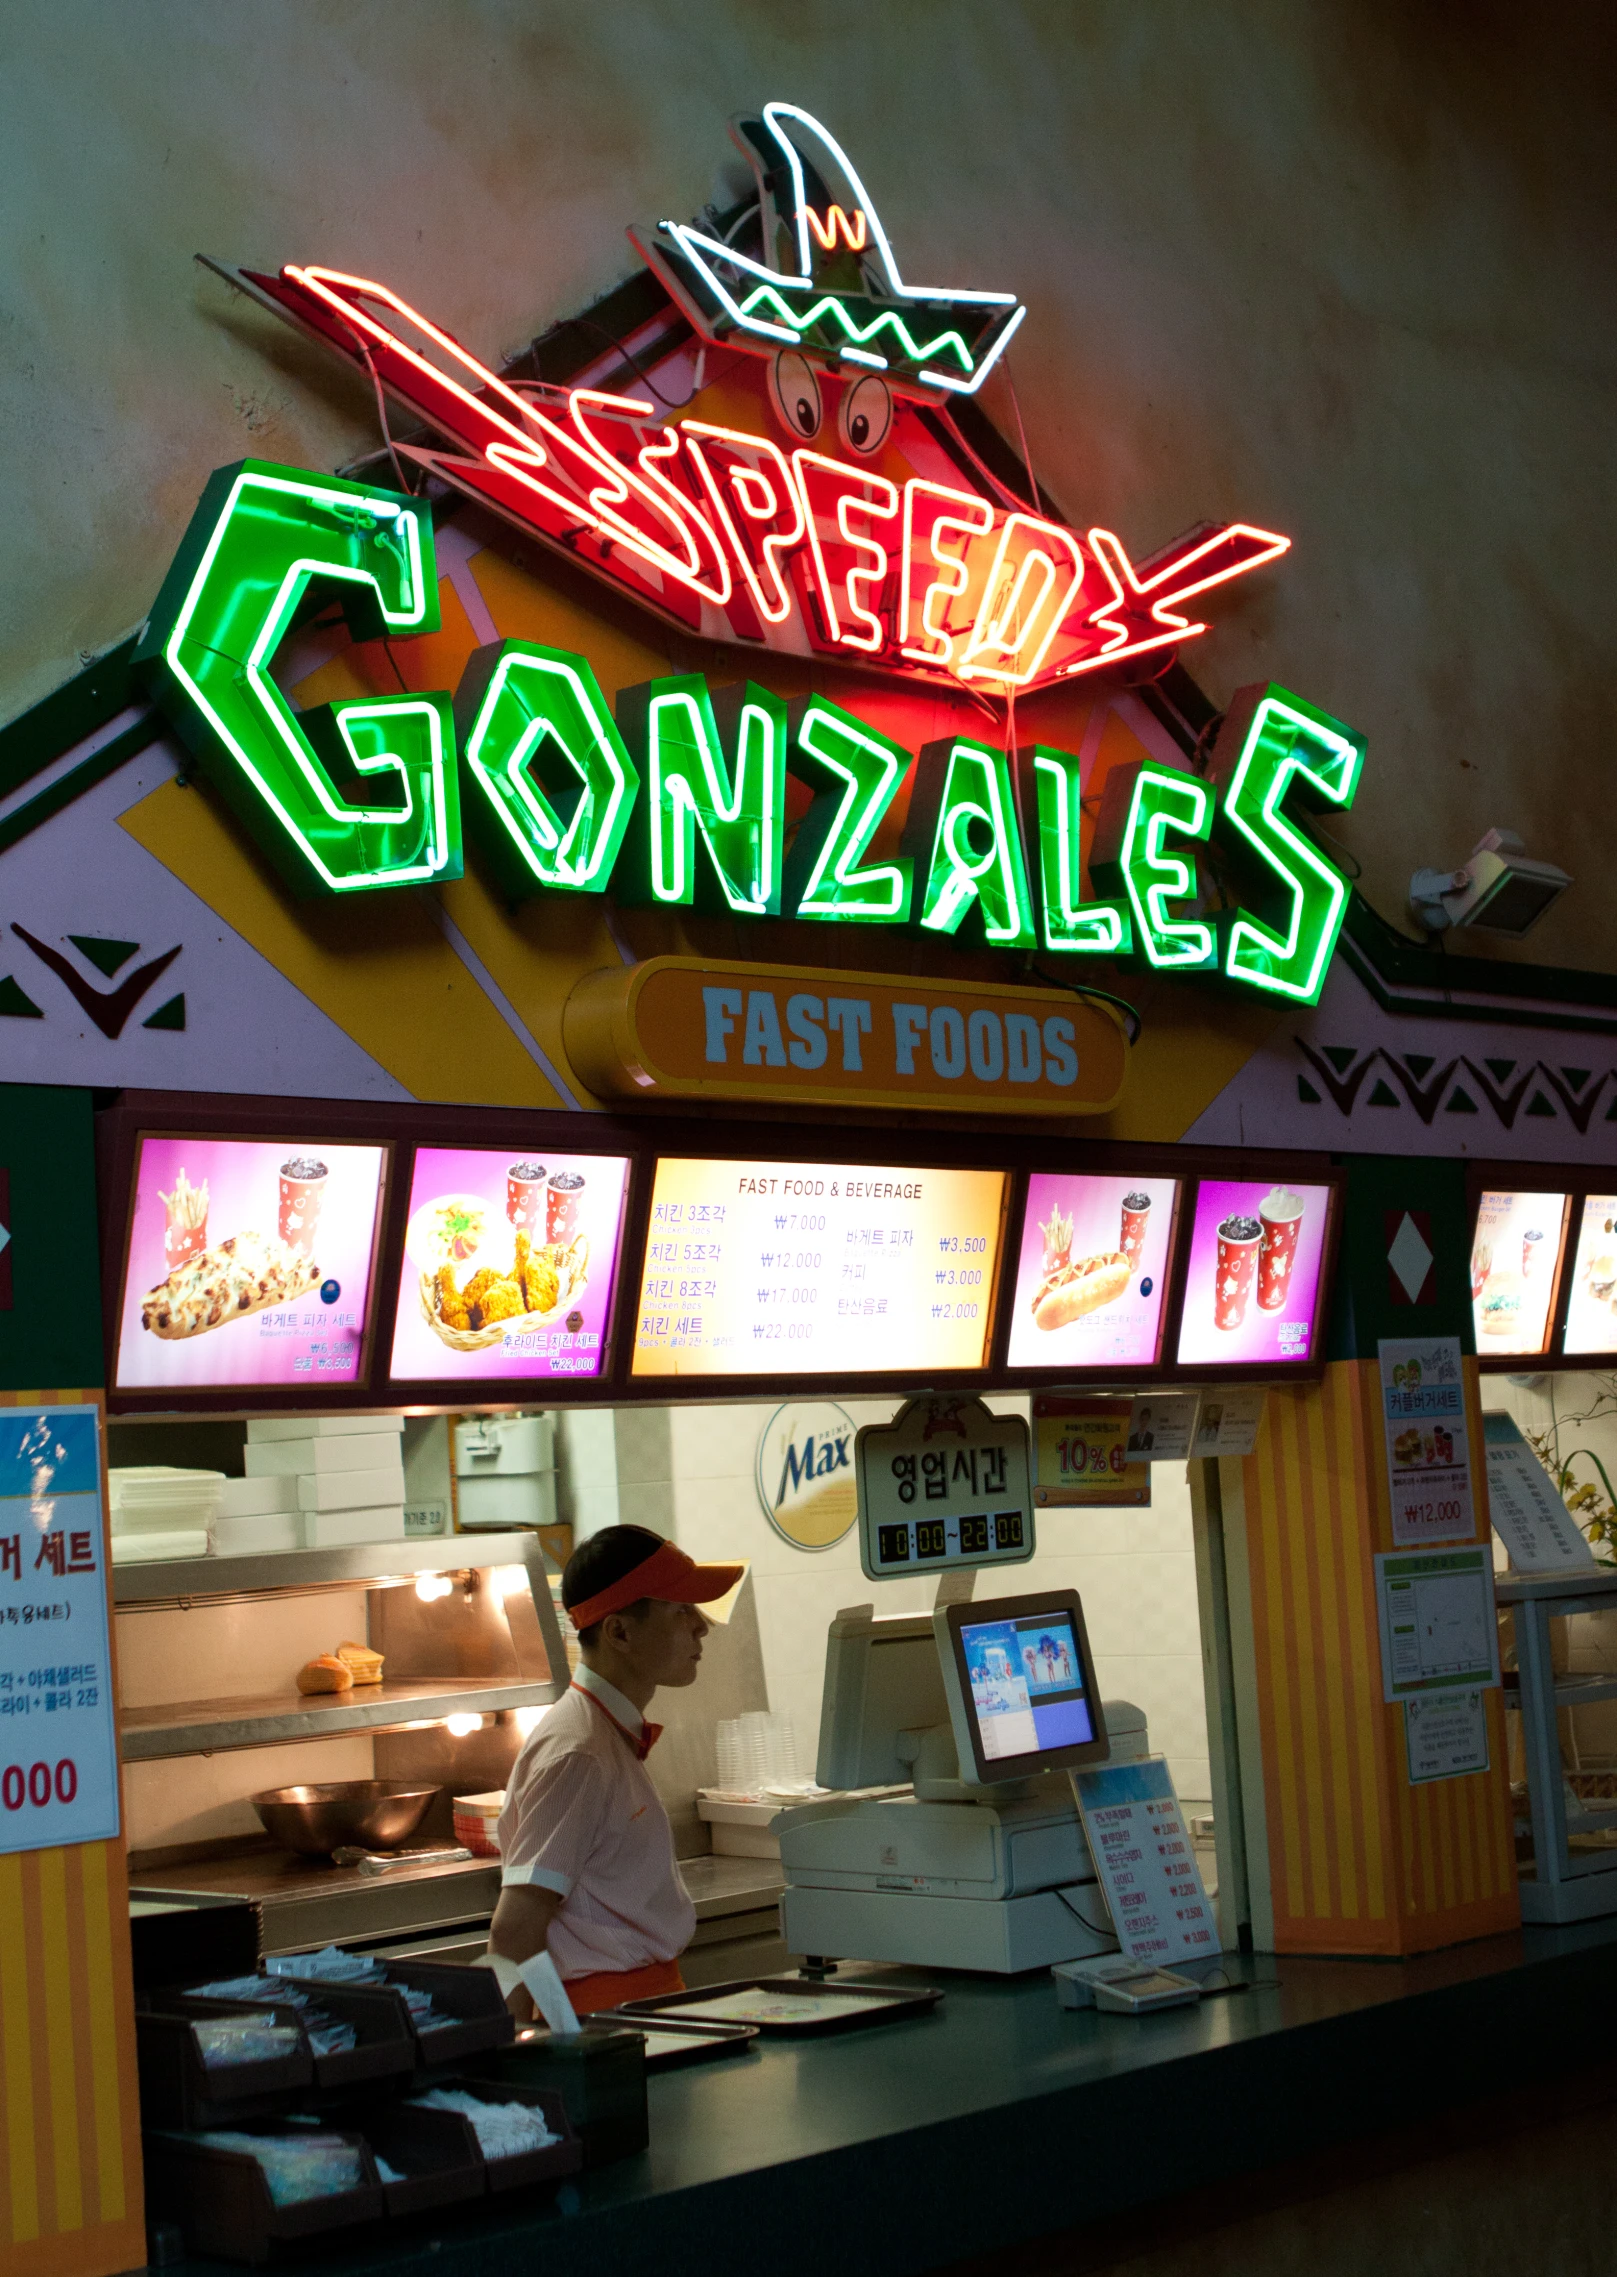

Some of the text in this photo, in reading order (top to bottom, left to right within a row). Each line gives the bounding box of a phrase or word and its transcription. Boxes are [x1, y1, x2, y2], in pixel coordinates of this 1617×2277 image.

[280, 264, 1293, 688] SPEEDY
[160, 457, 1368, 1006] GONZALES
[701, 985, 1079, 1087] FAST FOODS
[738, 1177, 924, 1199] FAST FOOD & BEVERAGE
[653, 1203, 727, 1224] 치킨 3조각
[846, 1229, 914, 1247] 바게트 피자
[649, 1242, 722, 1263] 치킨 5조각
[841, 1263, 867, 1281] 커피
[645, 1279, 717, 1299] 치킨 8조각
[837, 1297, 889, 1316] 탄산음료
[261, 1313, 357, 1327] 바게트 피자 세트
[640, 1316, 703, 1336] 치킨 세트
[502, 1334, 599, 1348] 후라이드 치킨 세트
[551, 1358, 595, 1372] ₩22,000
[1390, 1391, 1459, 1413] 커플버거세트
[818, 1422, 849, 1441] PRIME
[1056, 1436, 1108, 1473] 10%
[774, 1433, 852, 1511] Max
[891, 1446, 1009, 1504] 영업시간
[1404, 1499, 1461, 1525] ₩12,000
[34, 1529, 96, 1577] 세트
[28, 1664, 99, 1688] 야채샐러드
[45, 1692, 72, 1713] 콜라
[2, 1758, 78, 1811] 000
